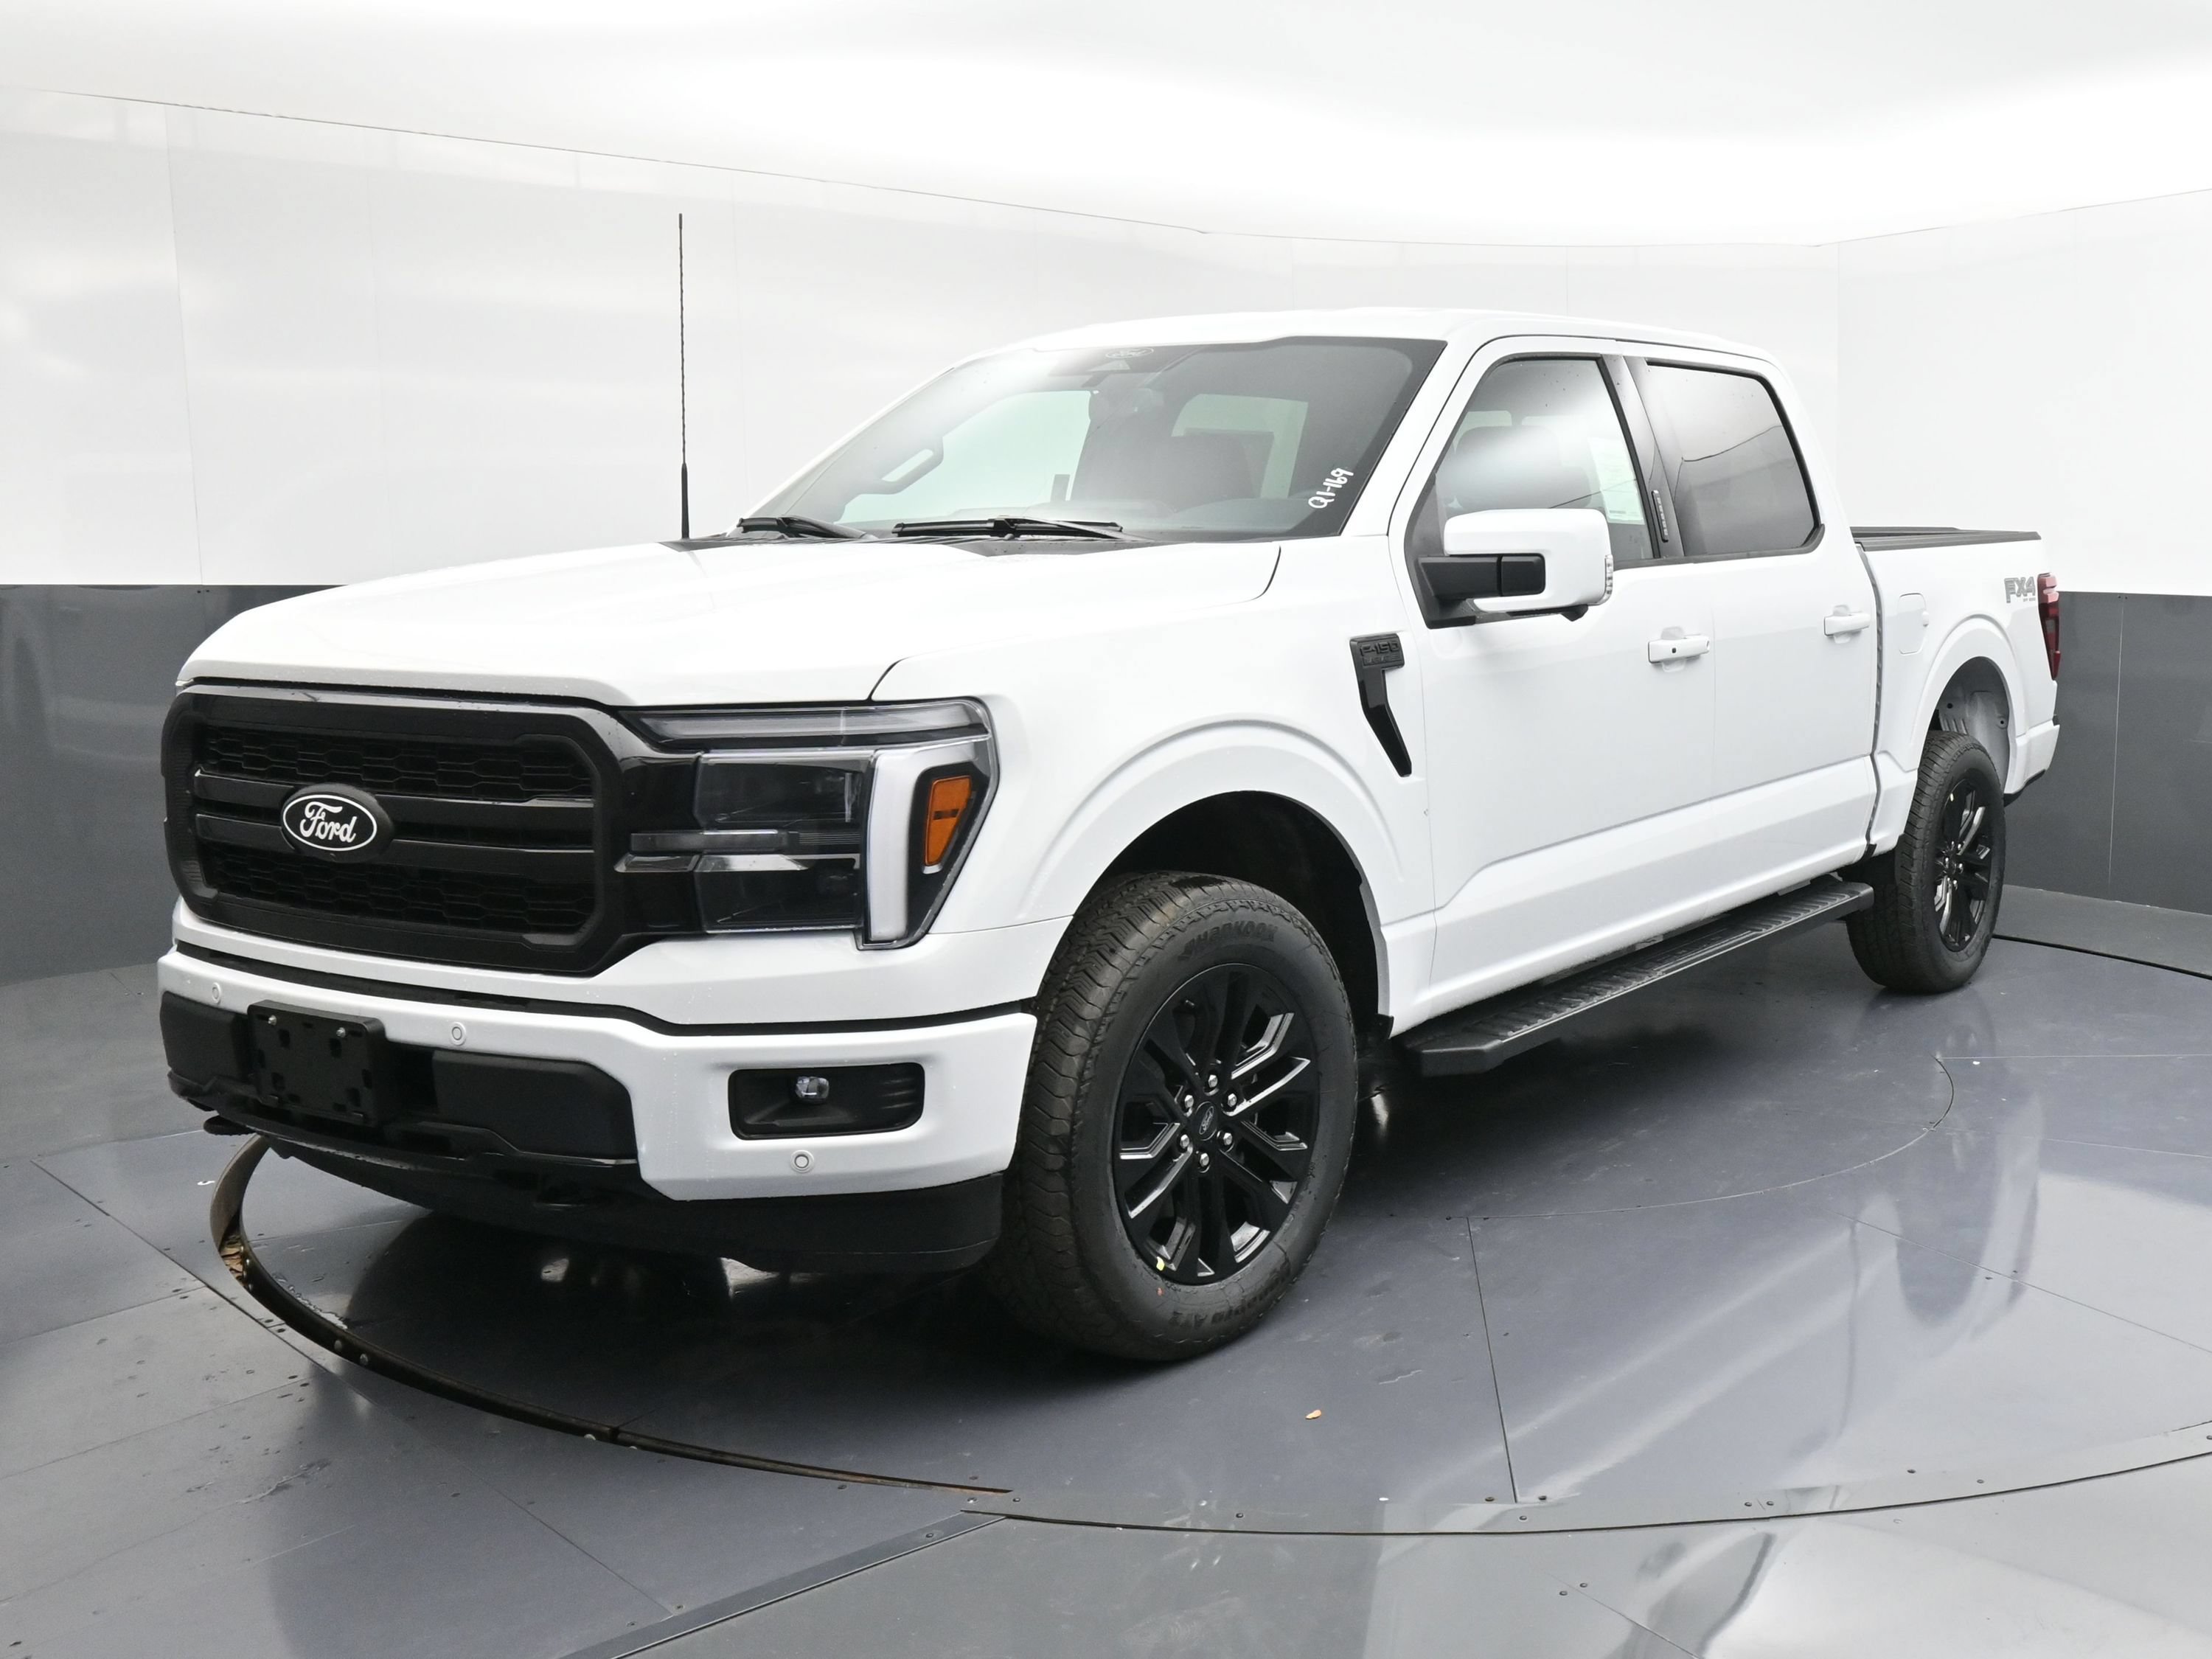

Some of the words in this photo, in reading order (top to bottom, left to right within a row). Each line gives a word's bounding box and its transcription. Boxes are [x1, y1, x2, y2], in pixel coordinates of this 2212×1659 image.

[1308, 467, 1354, 509] Q1-169
[2004, 576, 2036, 603] FX4
[299, 801, 358, 844] Ford
